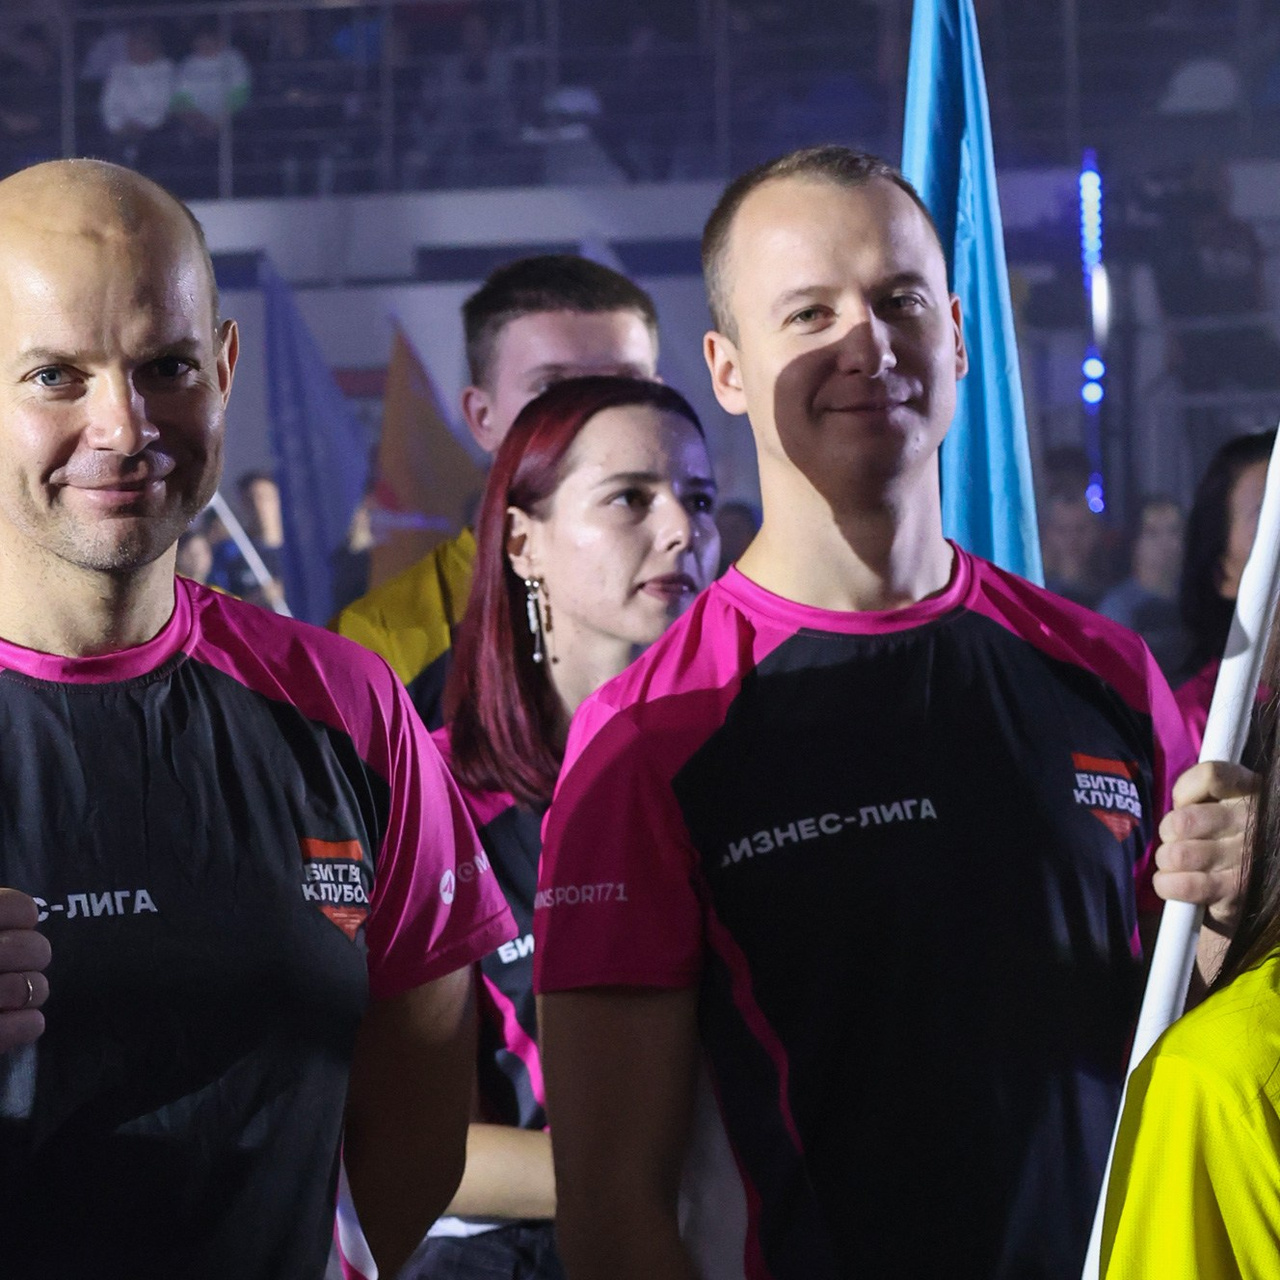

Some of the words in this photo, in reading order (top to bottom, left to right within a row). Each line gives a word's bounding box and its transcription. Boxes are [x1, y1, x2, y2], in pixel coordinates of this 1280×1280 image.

[1075, 773, 1140, 801] БИТВА
[303, 863, 361, 884] БИТВ
[302, 883, 370, 903] КЛУБО
